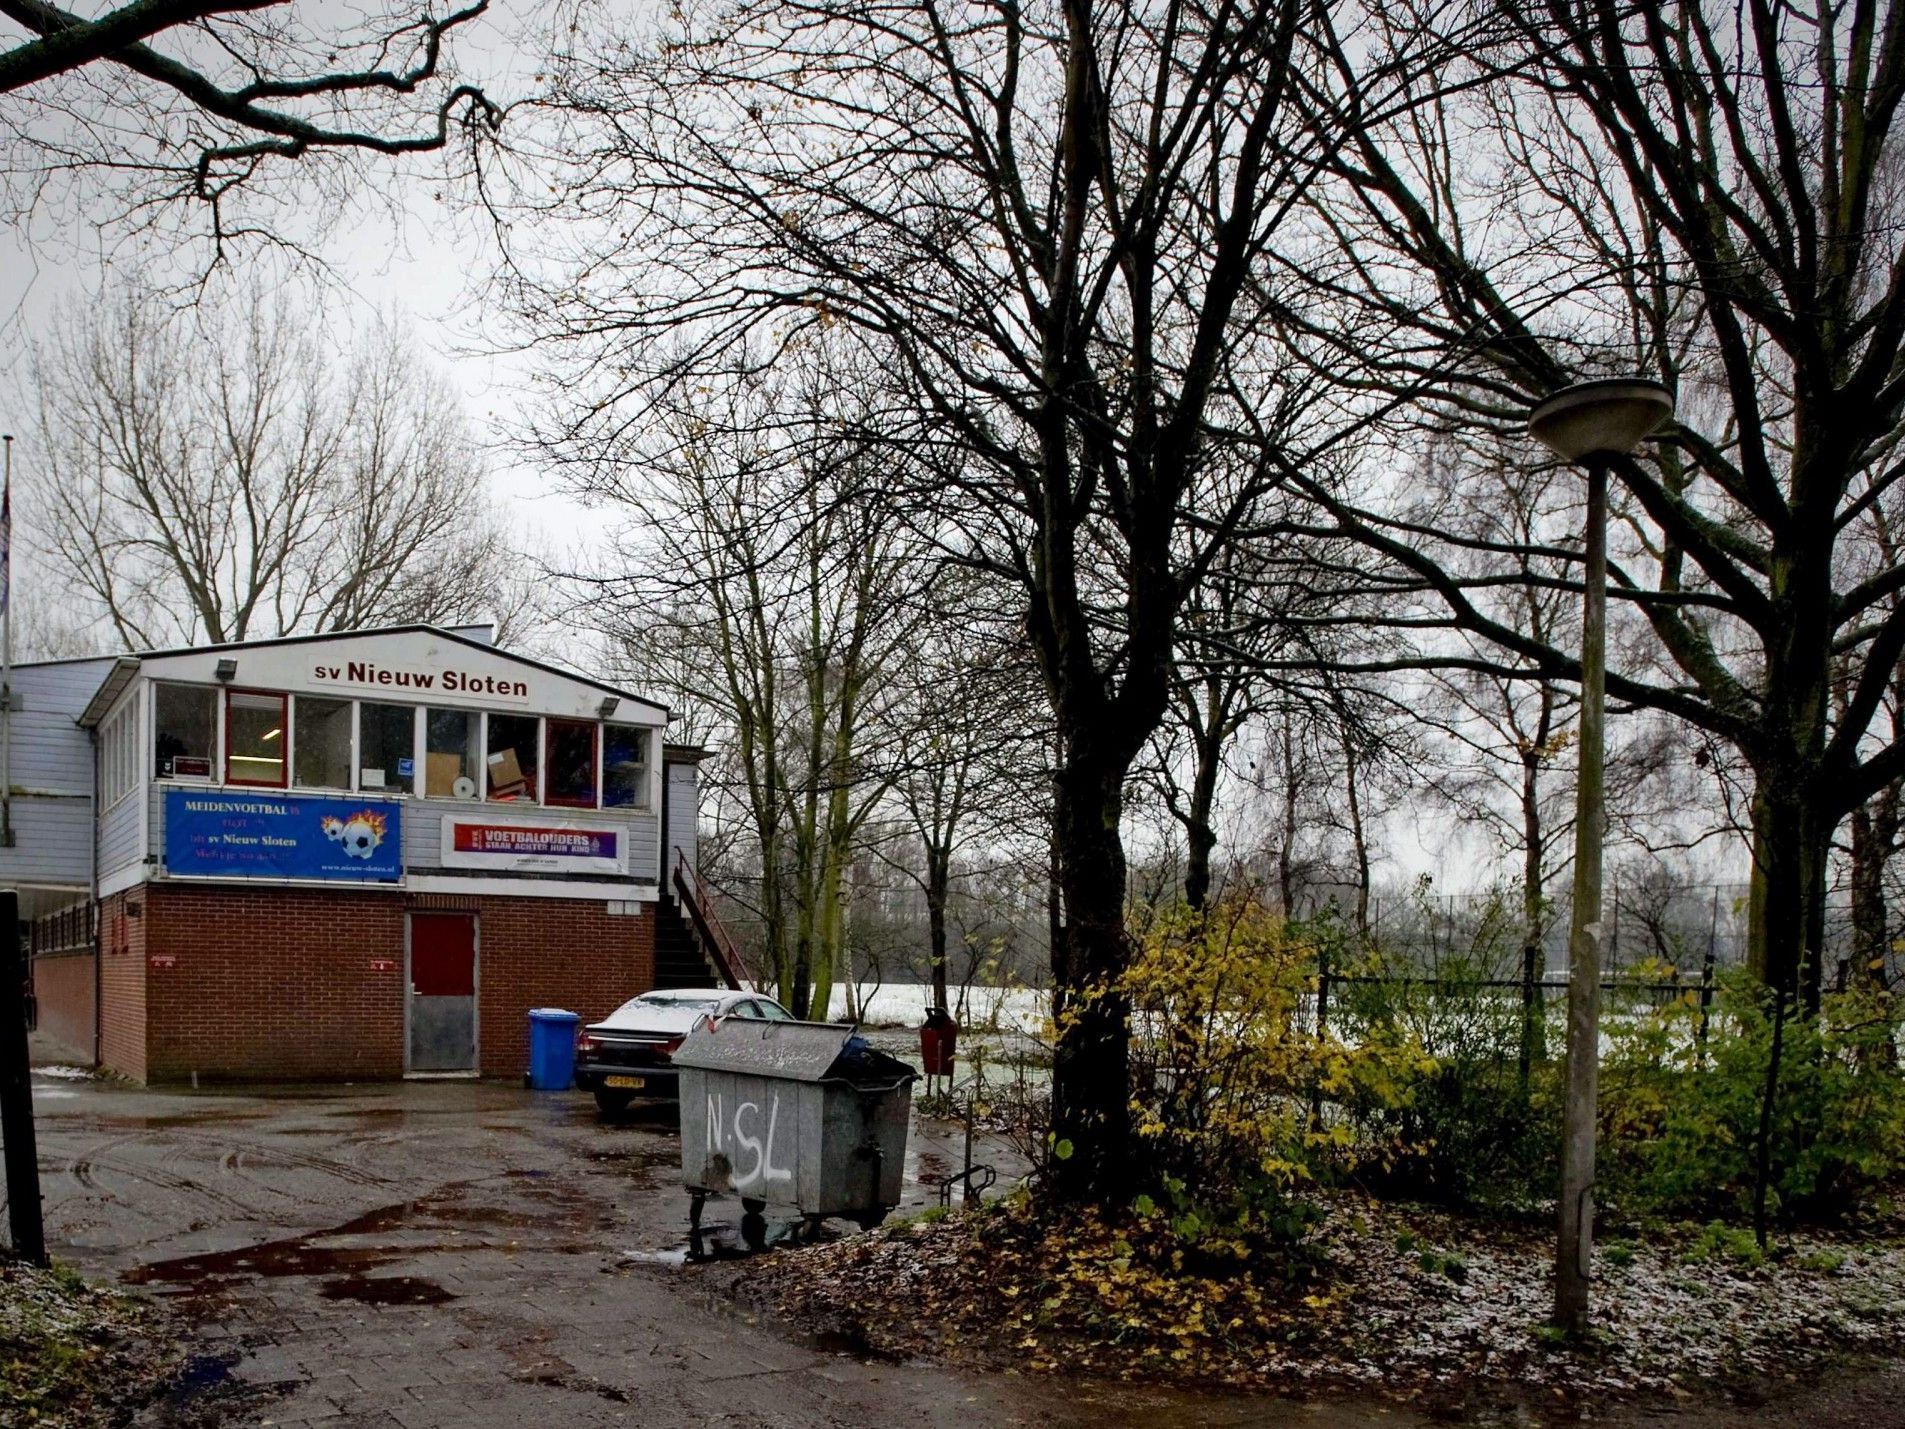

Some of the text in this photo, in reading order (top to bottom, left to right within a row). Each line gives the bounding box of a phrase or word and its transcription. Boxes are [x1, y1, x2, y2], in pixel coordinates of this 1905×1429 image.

[314, 662, 528, 696] sv Nieuw Sloten
[185, 800, 288, 816] MEIDENVOETBAL
[208, 836, 221, 844] sv
[223, 834, 259, 846] Nieuw
[261, 836, 297, 847] Sloten
[485, 829, 590, 846] VOETBALOUDERS
[514, 842, 548, 851] ACHTER
